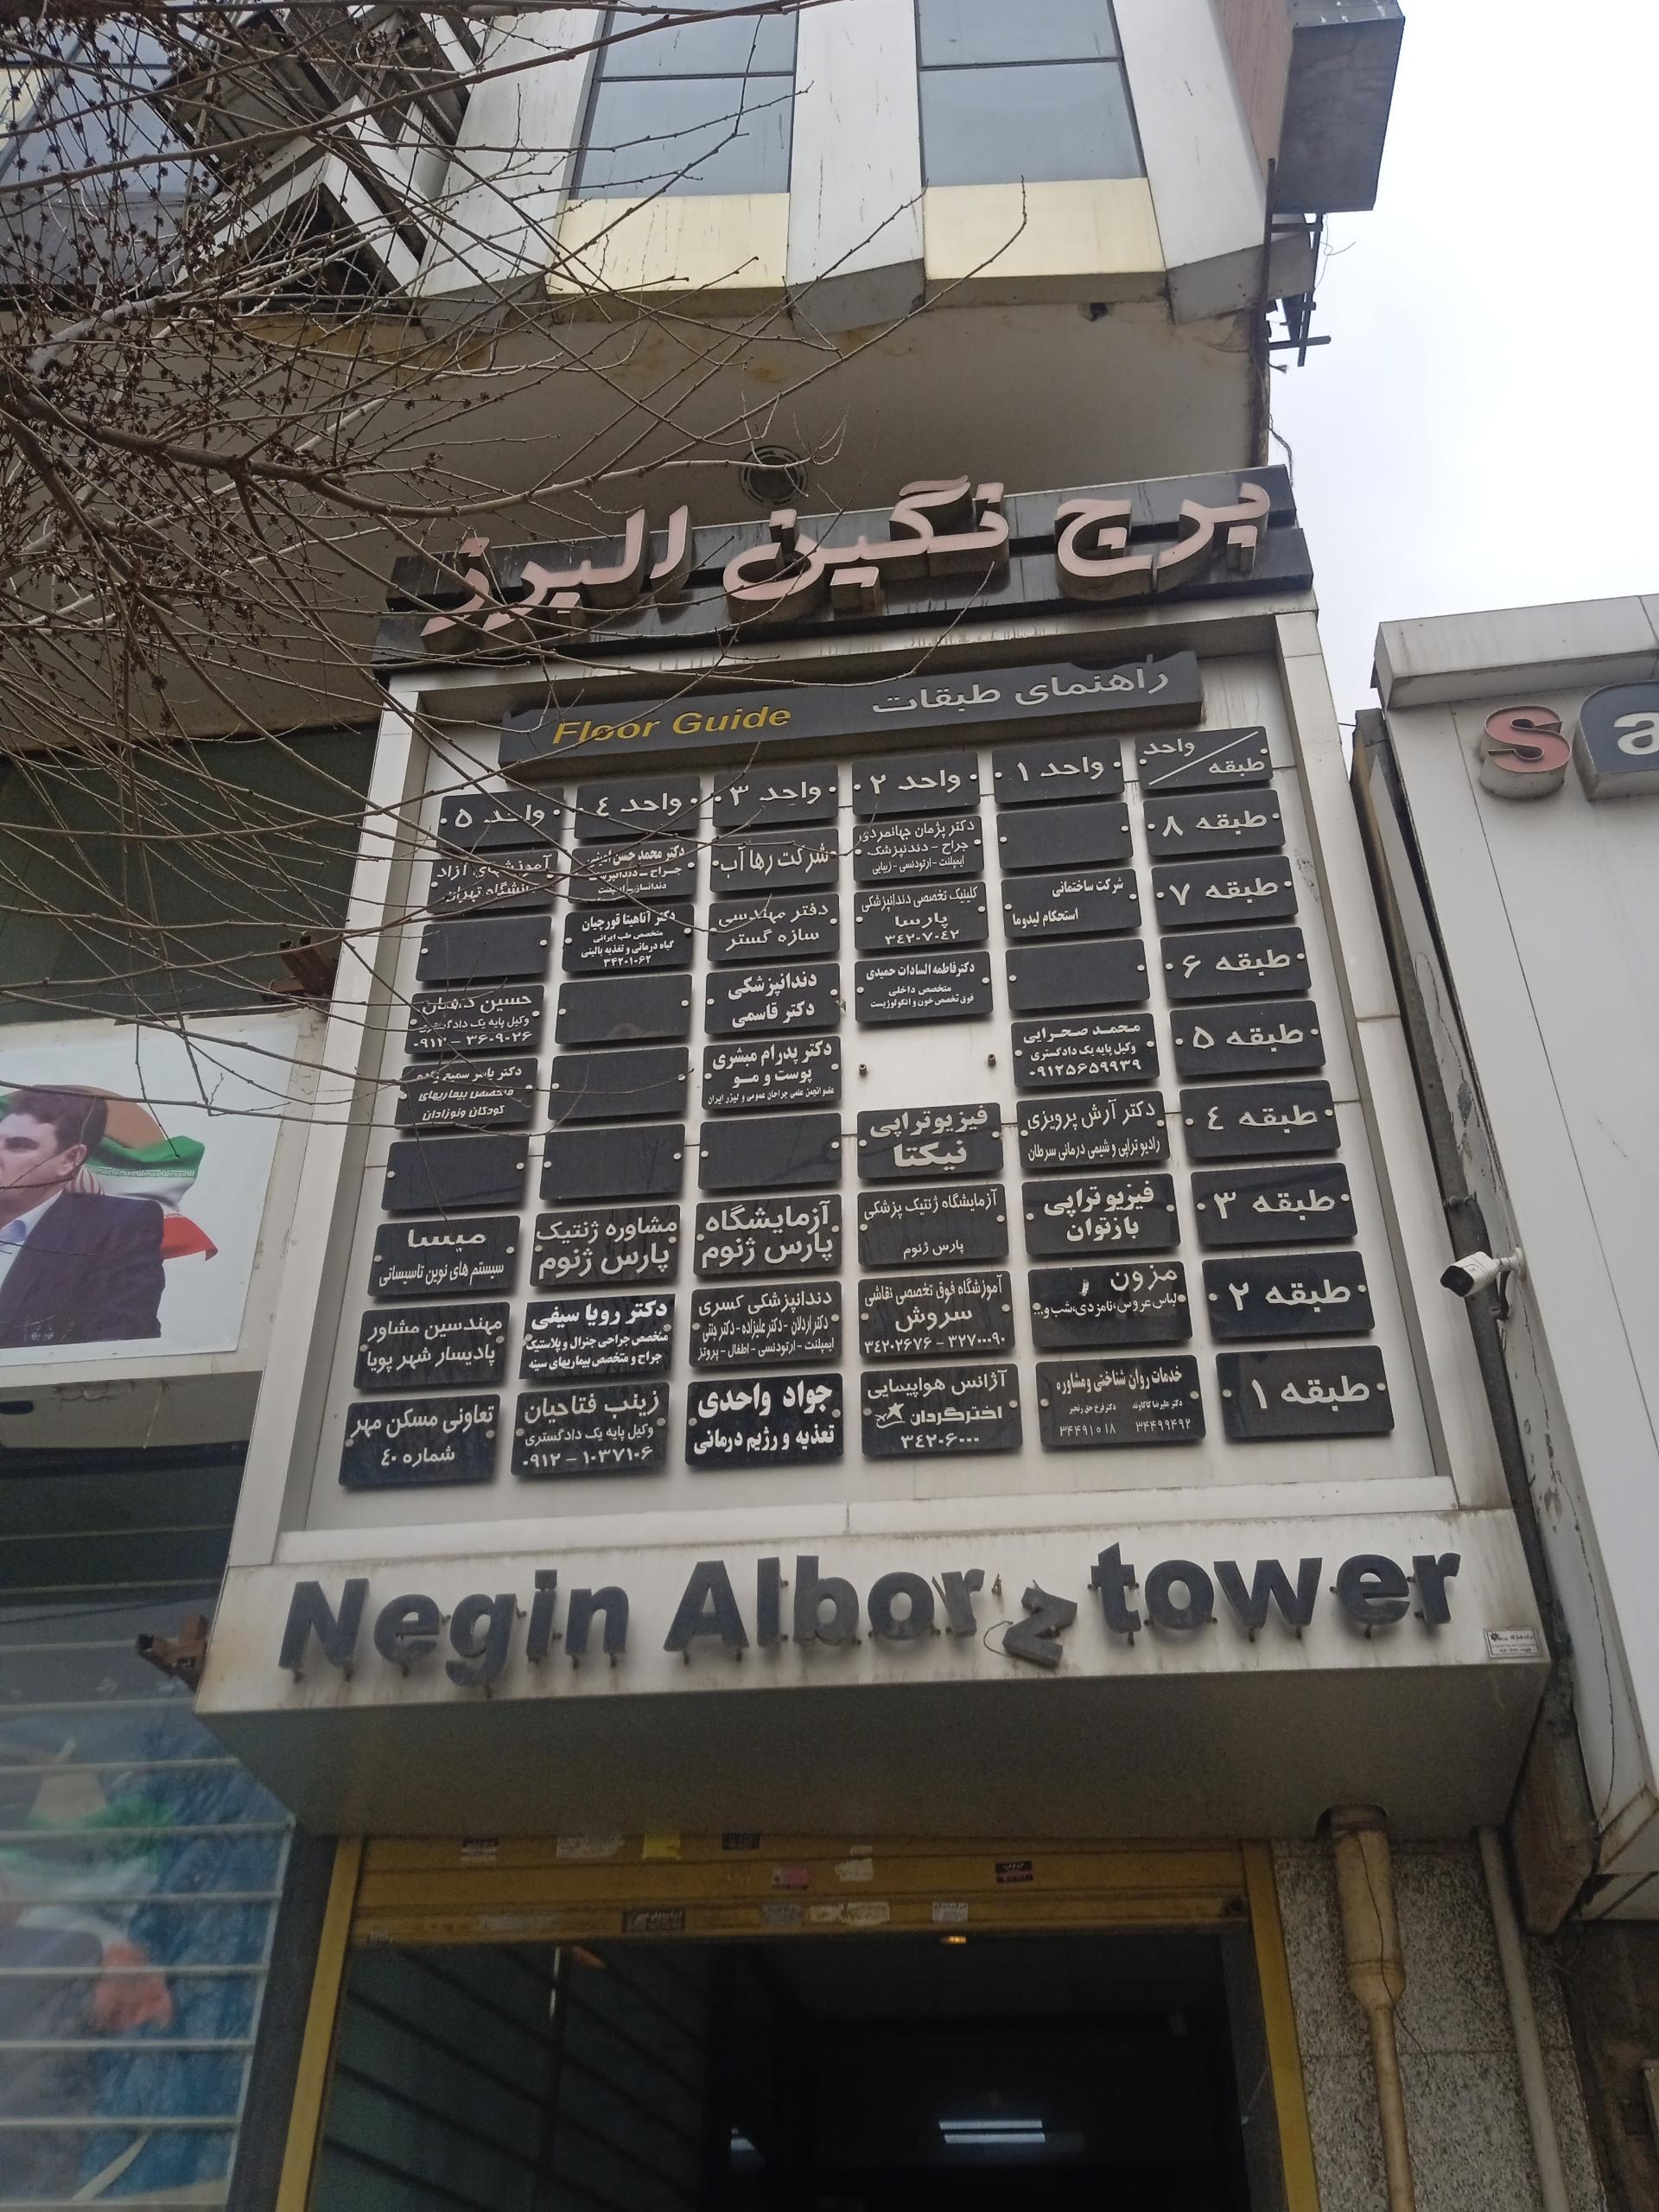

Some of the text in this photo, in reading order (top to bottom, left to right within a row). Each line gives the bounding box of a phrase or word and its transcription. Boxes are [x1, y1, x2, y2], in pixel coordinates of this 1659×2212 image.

[419, 474, 1270, 637] برج نگین البرز
[869, 663, 1169, 715] راهنمای طبقات
[552, 703, 792, 747] Floor Guide
[1143, 738, 1195, 757] واحد
[1017, 756, 1104, 782] واحد ۱
[1208, 757, 1265, 777] طبقه
[729, 781, 822, 806] واحد ۳
[869, 769, 961, 794] واحد ۲
[454, 808, 473, 828] ۵
[620, 792, 683, 817] واحد
[914, 819, 975, 839] دکتر پژمان
[1162, 810, 1267, 837] طبقه ۸
[638, 849, 663, 861] محمد
[720, 842, 830, 879] شرکت رها آب
[942, 839, 969, 855] جراح
[872, 855, 965, 875] ایمپلنت ارتودنسی زیبایی
[861, 886, 978, 913] کلینیک تخصصی دندانپزشکی
[1052, 877, 1124, 898] شرکت ساختمانی
[1169, 877, 1279, 906] طبقه ۷
[582, 910, 652, 932] آناهیتا قورچیان
[790, 902, 829, 924] دفتر
[894, 912, 949, 929] پارسا
[1042, 907, 1079, 927] استحکام
[581, 942, 658, 958] درمانی بالینی
[593, 930, 664, 944] متخصص ایرانی
[725, 928, 820, 952] سازه گستر
[866, 963, 931, 981] السادات حمیدی
[1182, 949, 1291, 979] طبقه ۶
[728, 970, 817, 1001] دندانپزشکی
[888, 984, 952, 997] متخصص داخلی
[480, 995, 532, 1014] حسین
[732, 1000, 815, 1028] دکتر قاسمی
[488, 1017, 505, 1029] پایه
[1023, 1024, 1141, 1044] محمد صحرایی
[1192, 1023, 1304, 1052] طبقه ۵
[712, 1039, 832, 1071] دکتر پدرام مبشری
[1030, 1046, 1077, 1062] دادگستری
[774, 1069, 813, 1084] پوست
[468, 1104, 505, 1118] کودکان
[708, 1090, 789, 1105] جراحان ایران
[1027, 1098, 1155, 1132] دکتر آرش پرویزی
[1238, 1104, 1318, 1134] طبقه
[893, 1140, 967, 1171] نیکتا
[1027, 1139, 1110, 1162] شیمی درمانی سرطان
[705, 1199, 831, 1235] آزمایشگاه
[864, 1187, 998, 1221] آزمایشگاه ژنتیک پزشکی
[1213, 1189, 1336, 1221] طبقه ۳
[536, 1216, 677, 1244] مشاوره ژنتیک
[1066, 1215, 1139, 1242] بازتوان
[538, 1242, 670, 1280] پارس ژنوم
[701, 1231, 833, 1269] پارس ژنوم
[903, 1239, 964, 1261] پارس ژنوم
[378, 1262, 505, 1287] سیستم نوین تاسیساتی
[1110, 1264, 1178, 1293] مزون
[698, 1290, 832, 1318] دندانپزشکی کسری
[864, 1274, 1003, 1307] آموزشگاه فوق تخصصی نقاشی
[1228, 1279, 1351, 1313] طبقه ۲
[531, 1300, 668, 1331] دکتر رویا سیفی
[895, 1306, 973, 1333] سروش
[366, 1317, 505, 1344] مهندسین مشاور
[569, 1331, 669, 1350] متخصص جراحی جنرال
[366, 1344, 495, 1374] پادیسار شهر پویا
[697, 1337, 835, 1362] ایمپلنت ارتودنسی اطفال پروتز
[528, 1355, 591, 1372] بیماریهای سینه
[867, 1369, 1008, 1400] آژانس هواپیمایی
[1093, 1365, 1182, 1393] خدمات روان شناختی
[524, 1390, 659, 1424] زینب فتاحیان
[697, 1379, 833, 1419] جواد واحدی
[1251, 1375, 1370, 1412] طبقه ۱
[349, 1404, 495, 1439] تعاونی مسکن مهر
[910, 1405, 1003, 1427] اخترگردان
[524, 1428, 582, 1447] دادگستری
[693, 1426, 779, 1455] رژیم درمانی
[403, 1445, 455, 1468] شماره
[277, 1568, 630, 1687] Negin
[1089, 1541, 1462, 1634] tower
